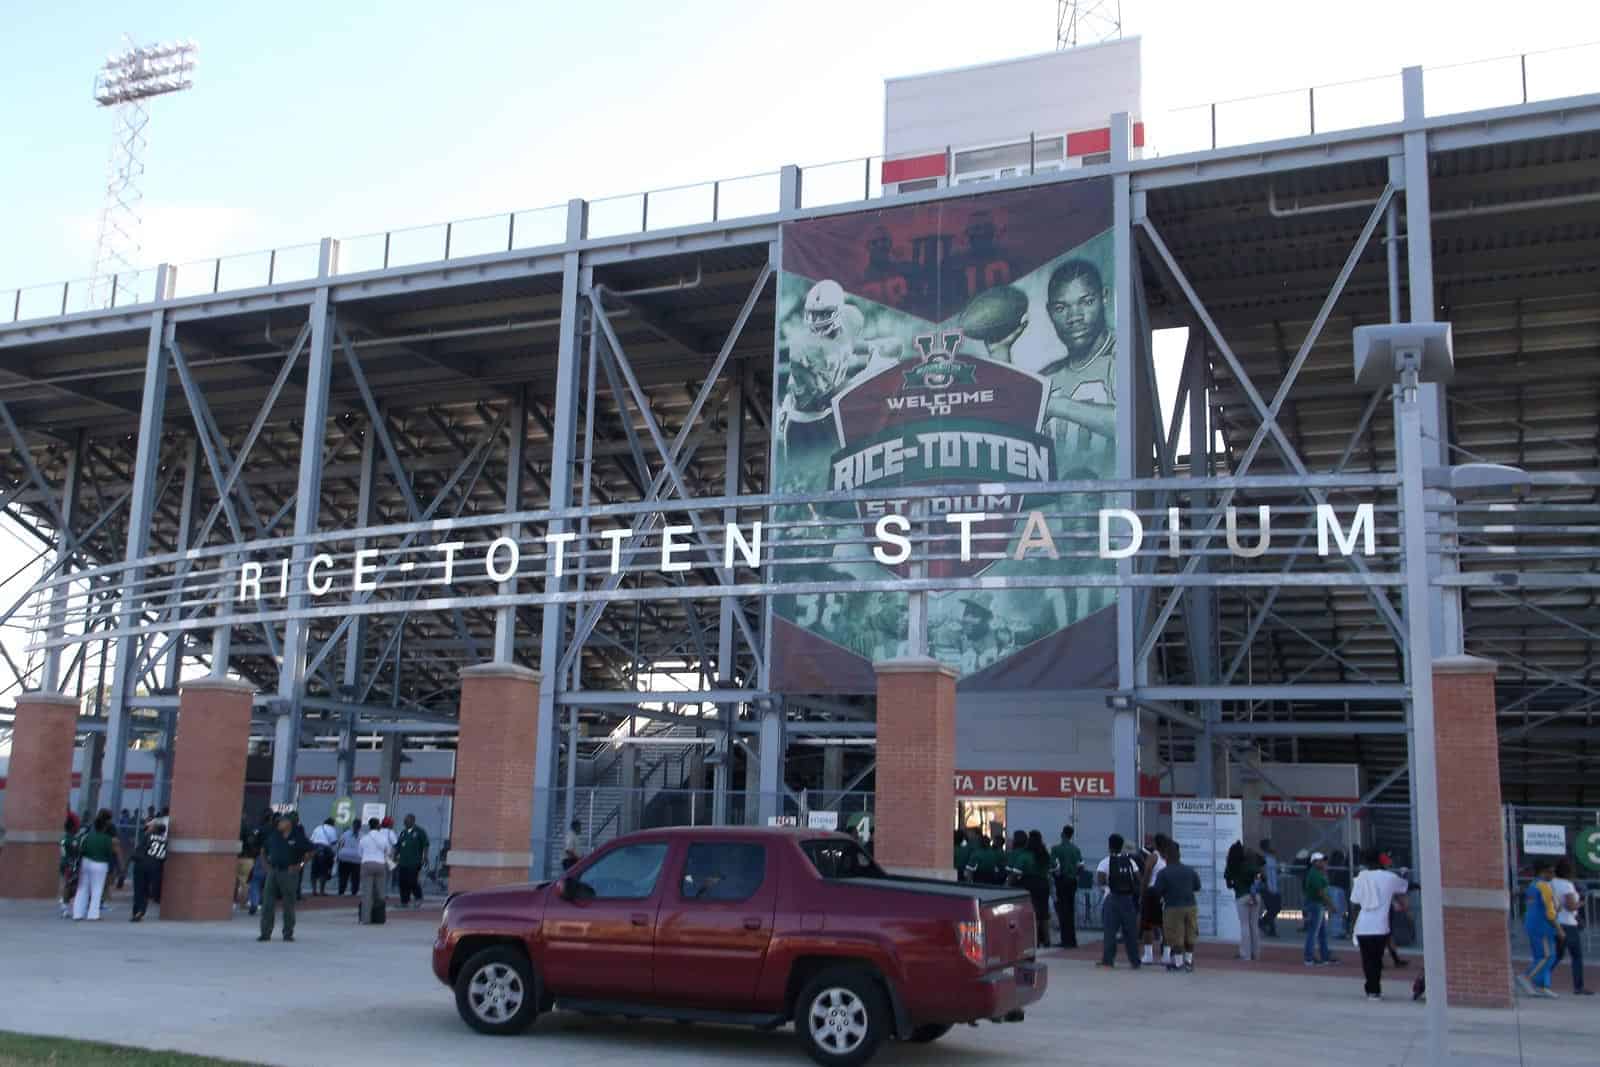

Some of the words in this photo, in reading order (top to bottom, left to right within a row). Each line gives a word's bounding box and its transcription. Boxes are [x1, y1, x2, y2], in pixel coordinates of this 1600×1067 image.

[887, 390, 994, 410] WELCOME
[928, 405, 951, 416] TO
[833, 431, 1049, 492] RICE-TOTTEN
[239, 521, 762, 601] RICE-TOTTEN
[872, 503, 1377, 565] STADIUM
[984, 776, 1039, 791] DEVIL
[1060, 777, 1111, 793] EVEL
[336, 802, 351, 824] 5
[1266, 801, 1312, 815] FIRT
[856, 816, 871, 842] 4
